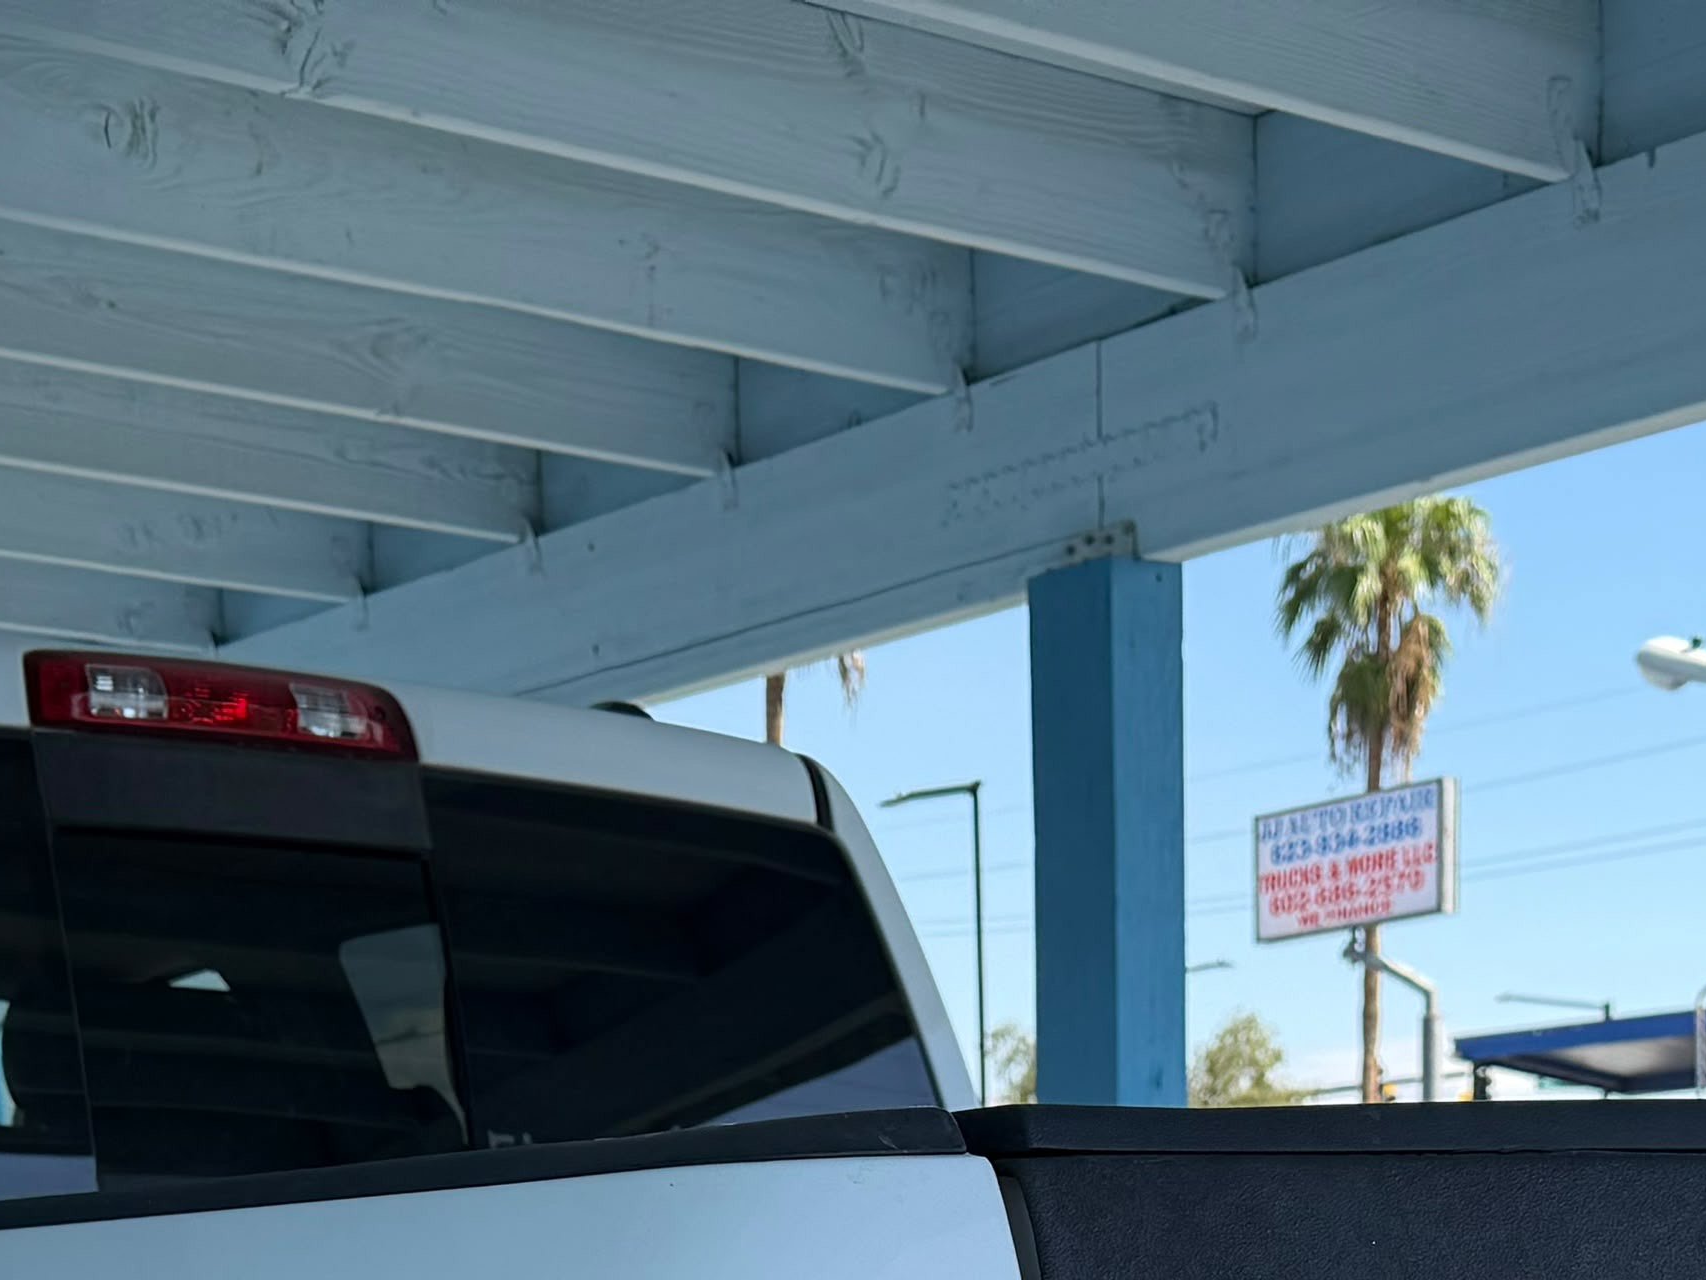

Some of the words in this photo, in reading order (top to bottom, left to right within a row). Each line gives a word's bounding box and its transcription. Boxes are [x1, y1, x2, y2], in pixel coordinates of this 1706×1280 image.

[1285, 808, 1349, 837] AUTO
[1351, 788, 1434, 824] REPAIR
[1259, 865, 1321, 895] TRUCKS
[1329, 861, 1340, 880] &
